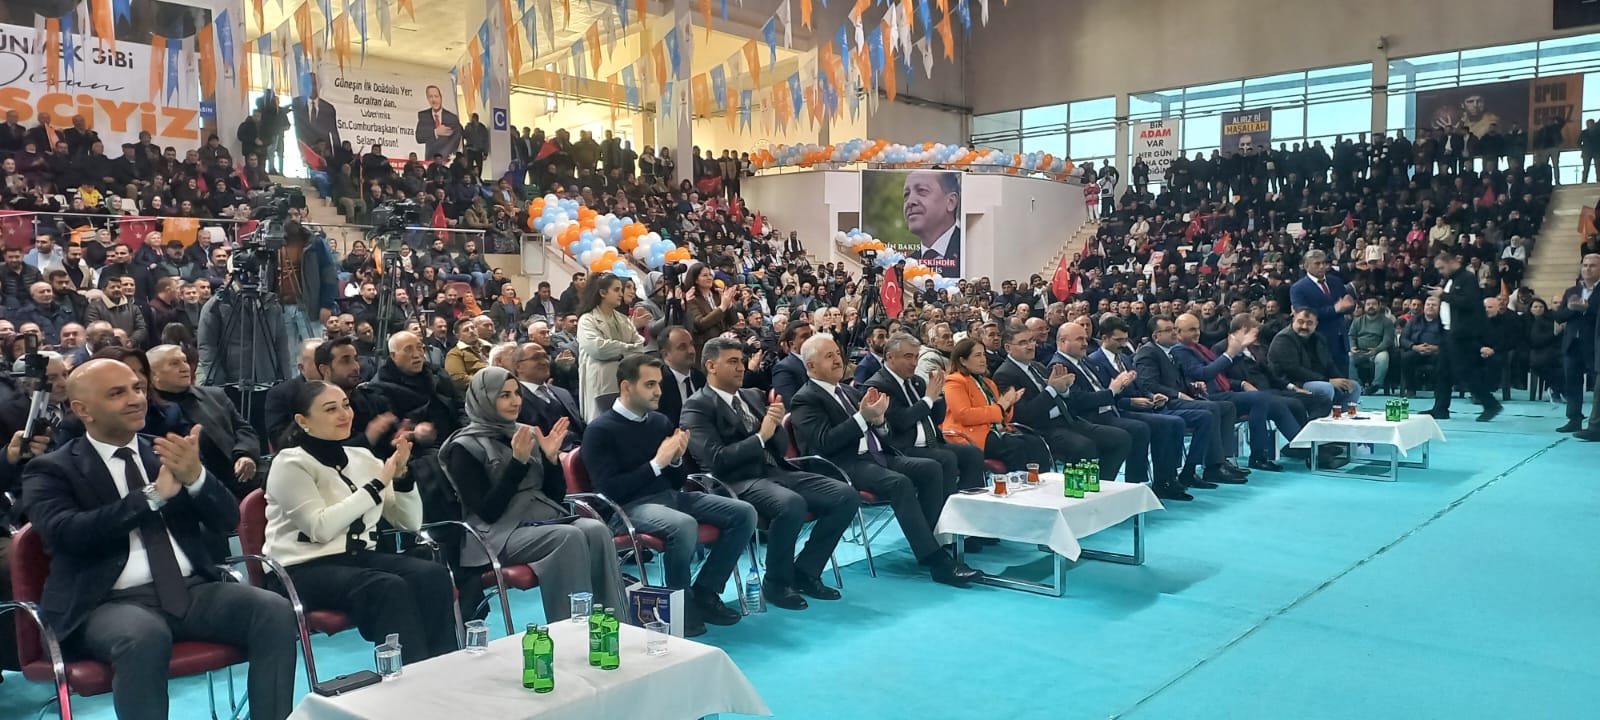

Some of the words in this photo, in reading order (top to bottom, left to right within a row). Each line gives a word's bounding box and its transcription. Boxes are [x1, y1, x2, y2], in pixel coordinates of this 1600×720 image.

[334, 78, 362, 92] Güneşin
[373, 83, 399, 95] Doğduğu
[494, 111, 505, 127] C
[1139, 129, 1171, 138] ADAM
[356, 135, 376, 145] Selam
[1154, 149, 1172, 157] GÜN
